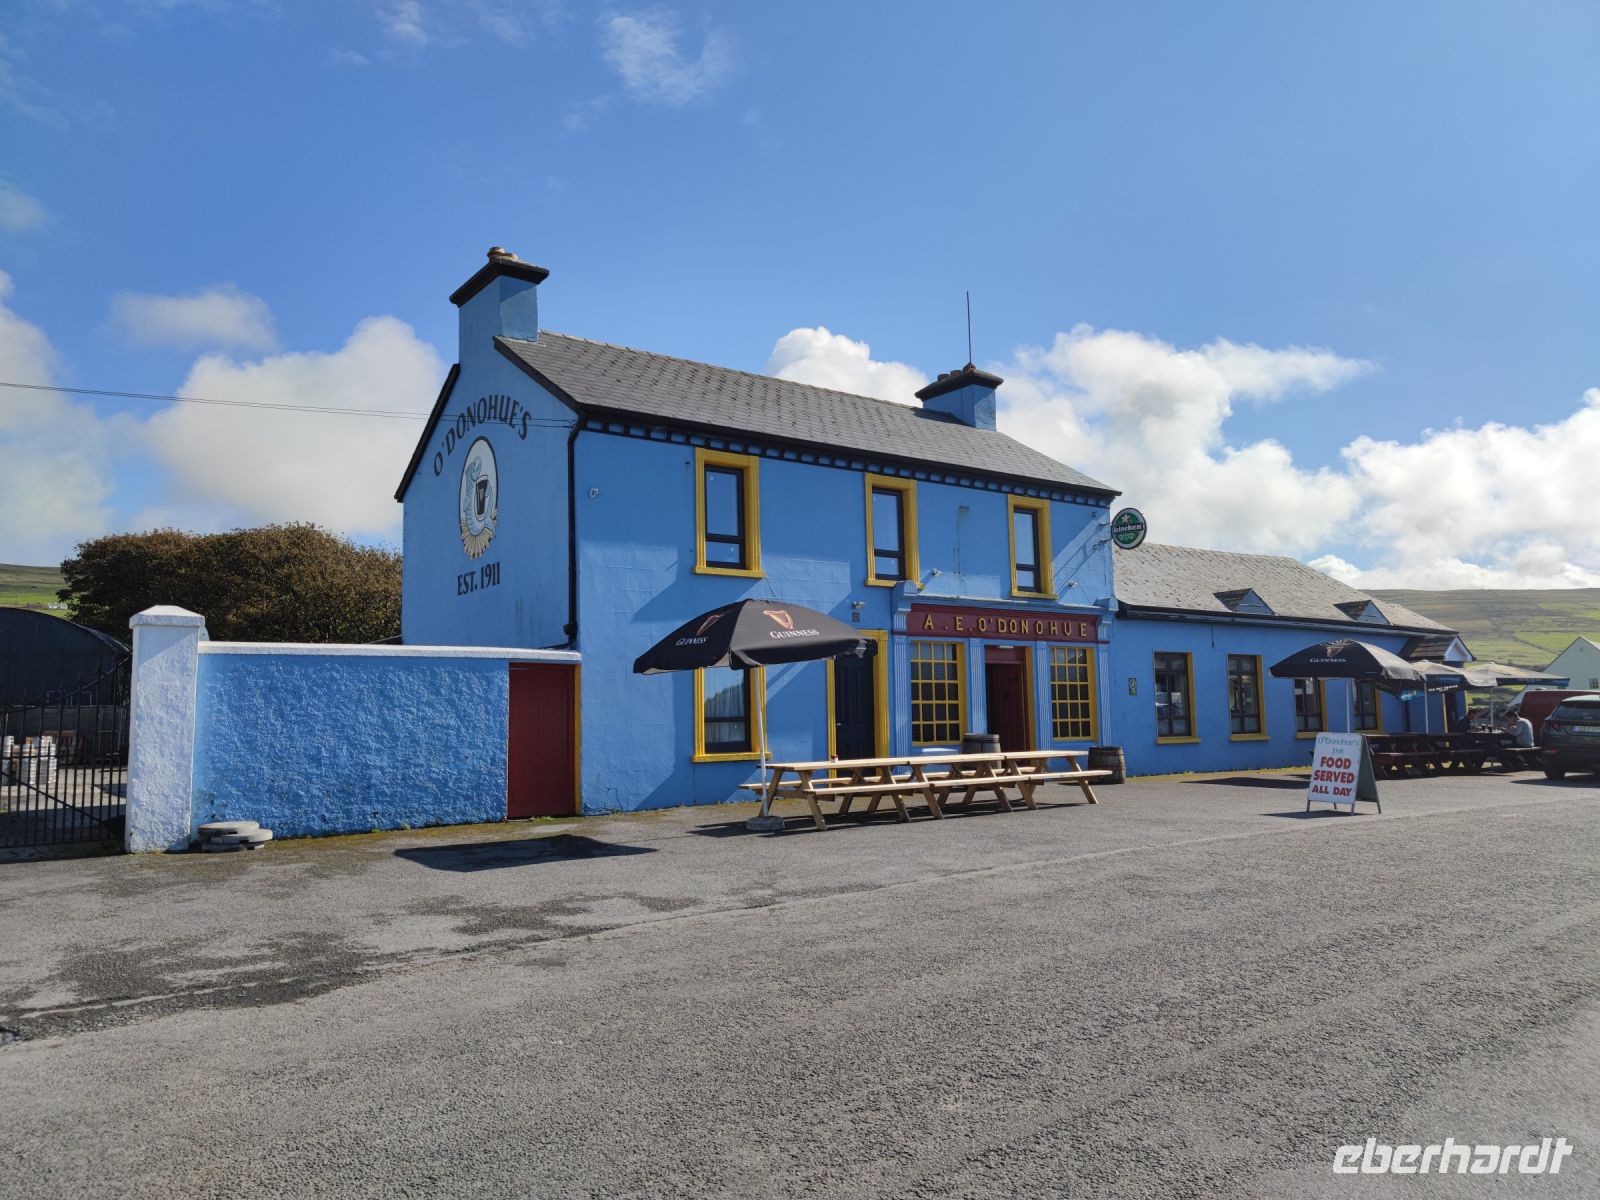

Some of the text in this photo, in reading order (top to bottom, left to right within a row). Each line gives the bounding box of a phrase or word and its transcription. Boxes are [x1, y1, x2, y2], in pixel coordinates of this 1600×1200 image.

[433, 395, 531, 476] O'DONOHUE'S
[457, 562, 500, 596] EST. 1911
[978, 616, 1087, 637] O'DONOHUE
[769, 629, 820, 640] GUINNESS
[1320, 756, 1351, 769] FOOD
[1313, 769, 1354, 784] SERVED
[1311, 784, 1352, 796] ALL DAY
